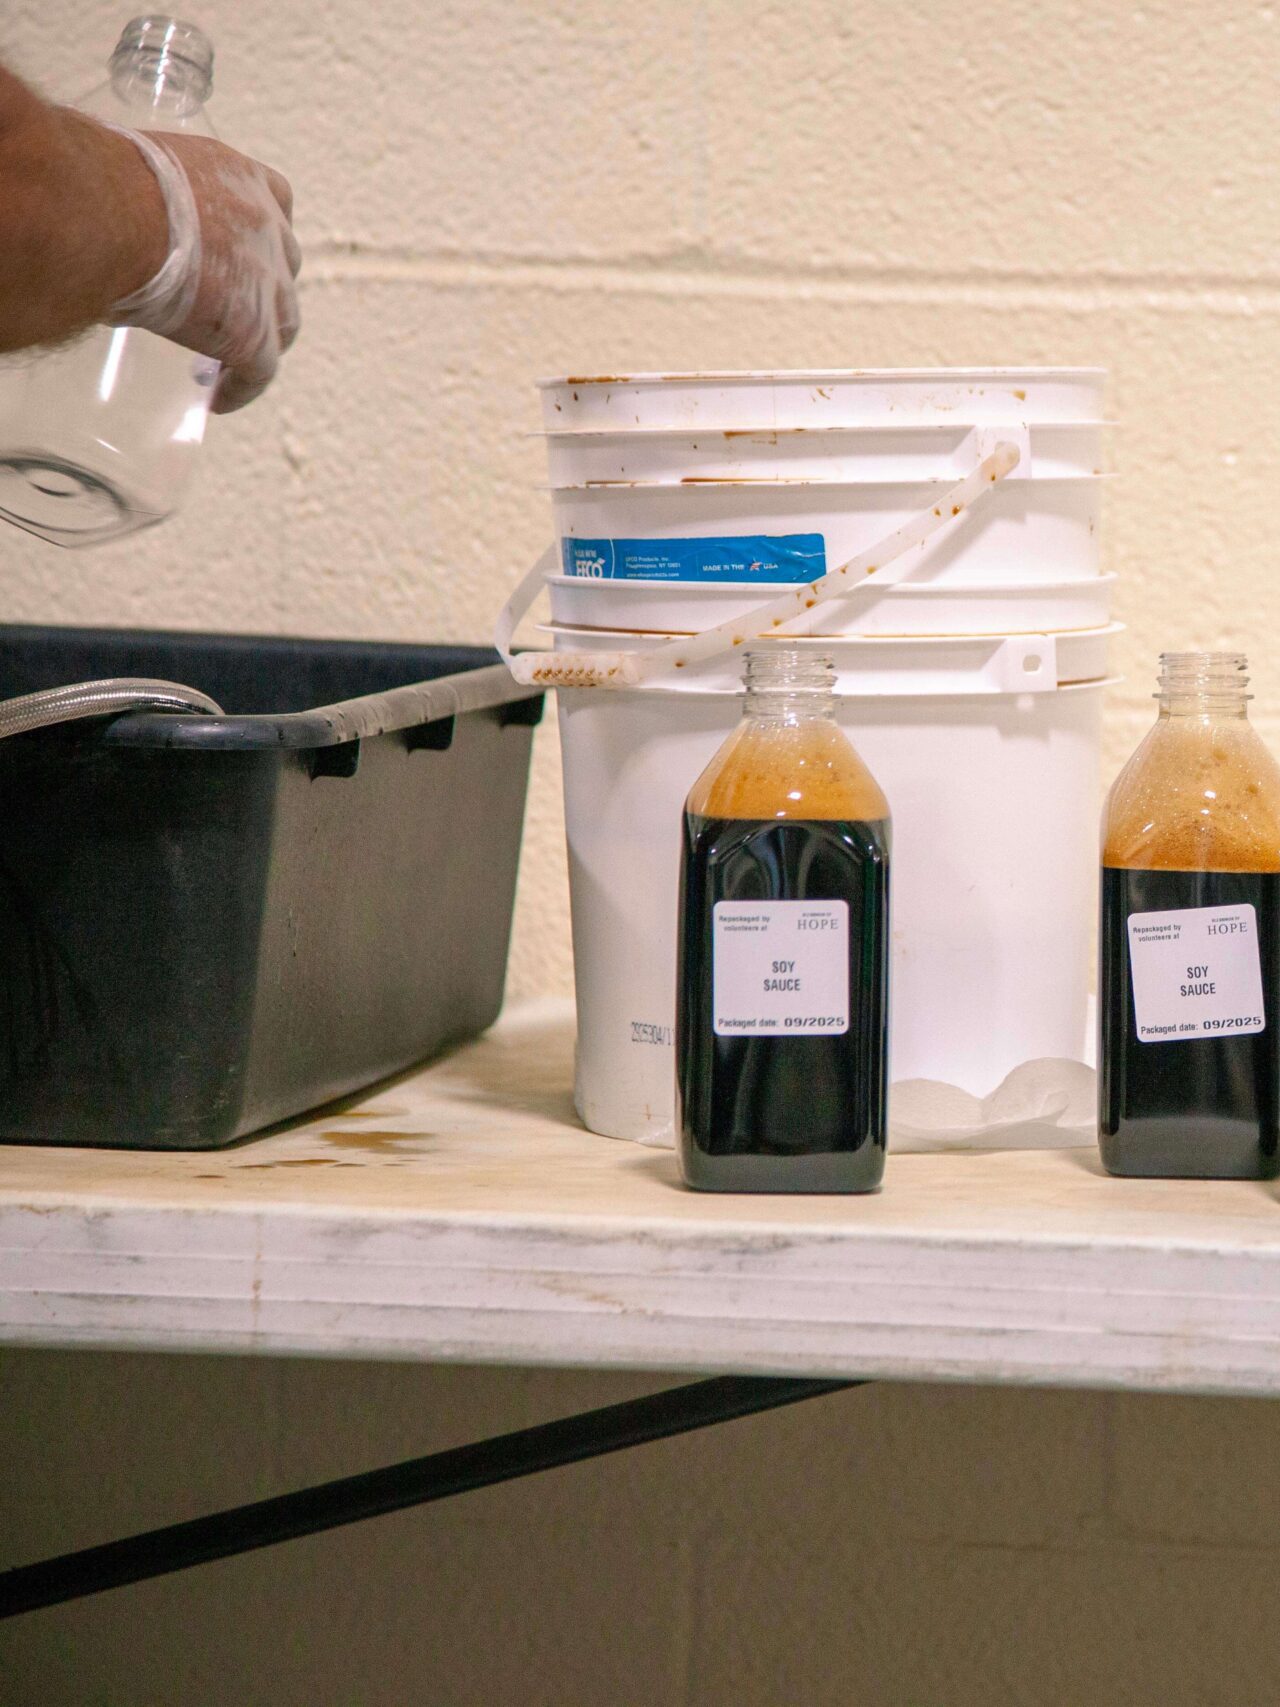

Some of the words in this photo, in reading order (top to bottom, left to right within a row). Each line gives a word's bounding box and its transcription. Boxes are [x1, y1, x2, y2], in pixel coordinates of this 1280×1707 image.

[762, 915, 770, 923] by
[798, 919, 839, 930] HOPE
[1132, 924, 1172, 934] Repackaged
[1207, 922, 1248, 936] HOPE
[1138, 934, 1172, 942] volunteers
[772, 960, 796, 974] SOY
[1186, 966, 1209, 979] SOY
[763, 978, 801, 992] SAUCE
[1180, 982, 1216, 996] SAUCE
[718, 1018, 756, 1028] Packaged
[784, 1017, 845, 1028] 09/2025
[1140, 1024, 1176, 1035] Packaged
[1202, 1016, 1262, 1030] 09/2025
